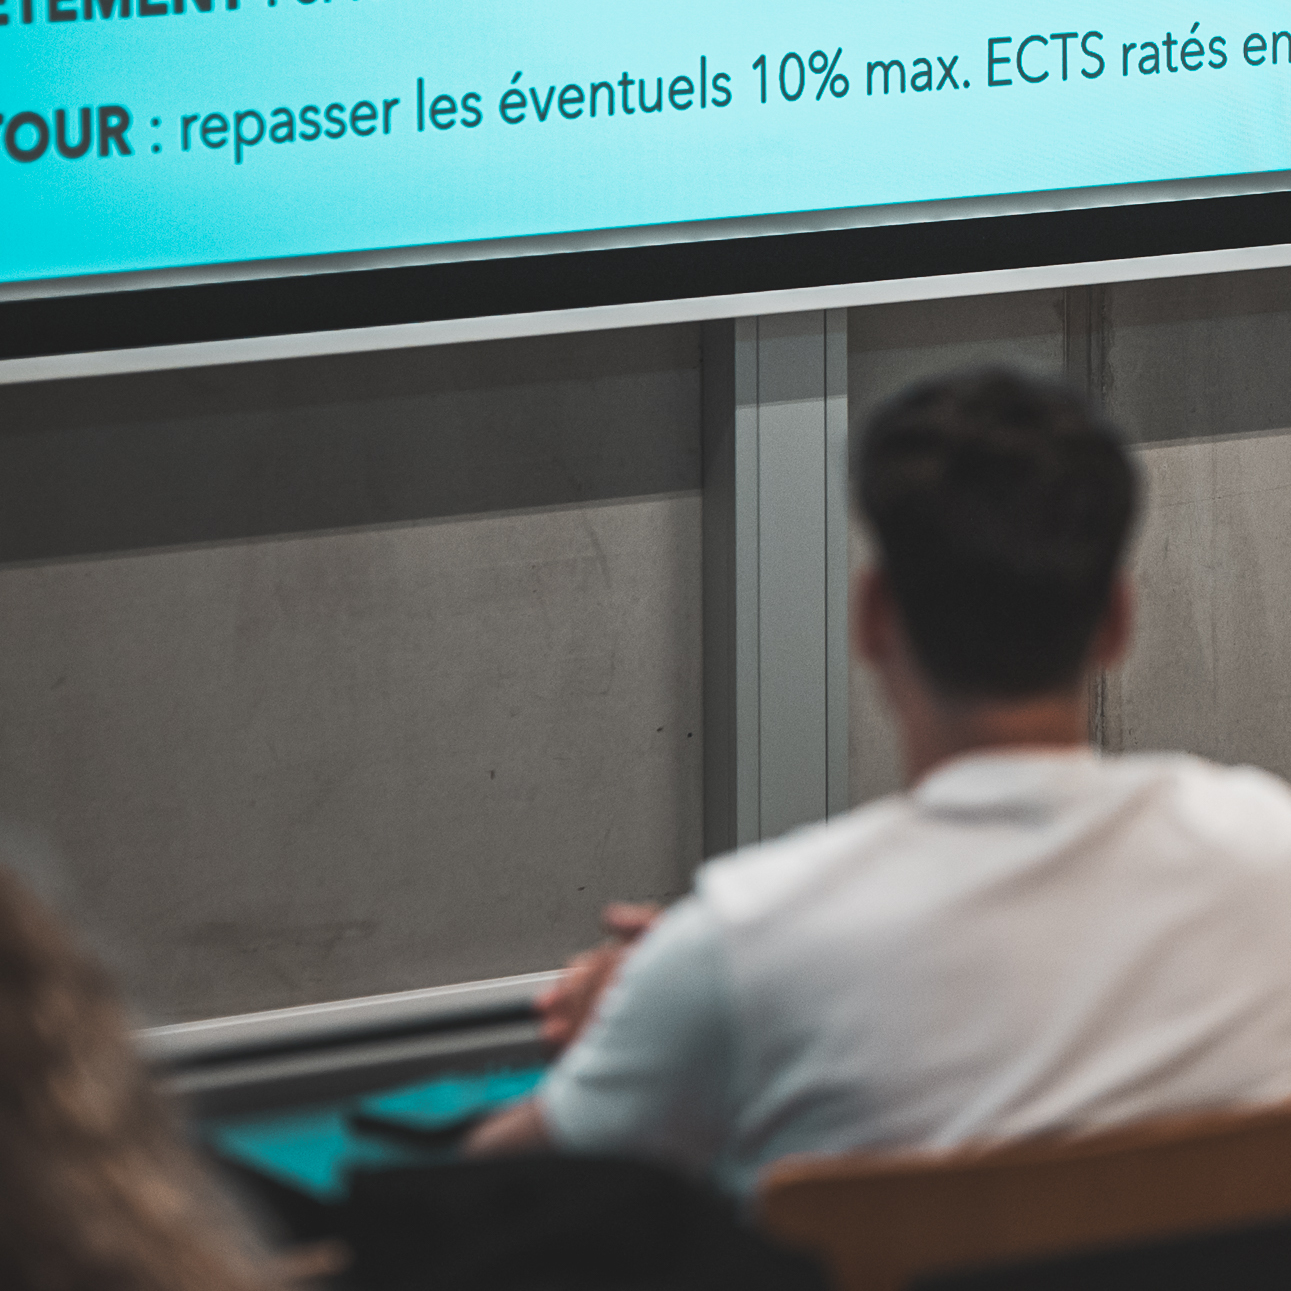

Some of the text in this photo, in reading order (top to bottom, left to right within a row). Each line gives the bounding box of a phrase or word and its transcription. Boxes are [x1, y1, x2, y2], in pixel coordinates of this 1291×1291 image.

[0, 104, 132, 164] OUR
[151, 118, 161, 153] :
[182, 98, 400, 164] repasser
[417, 77, 482, 132] les
[499, 55, 732, 124] éventuels
[752, 47, 849, 104] 10%
[867, 55, 970, 96] max.
[987, 31, 1105, 87] ECTS
[1122, 21, 1228, 77] ratés
